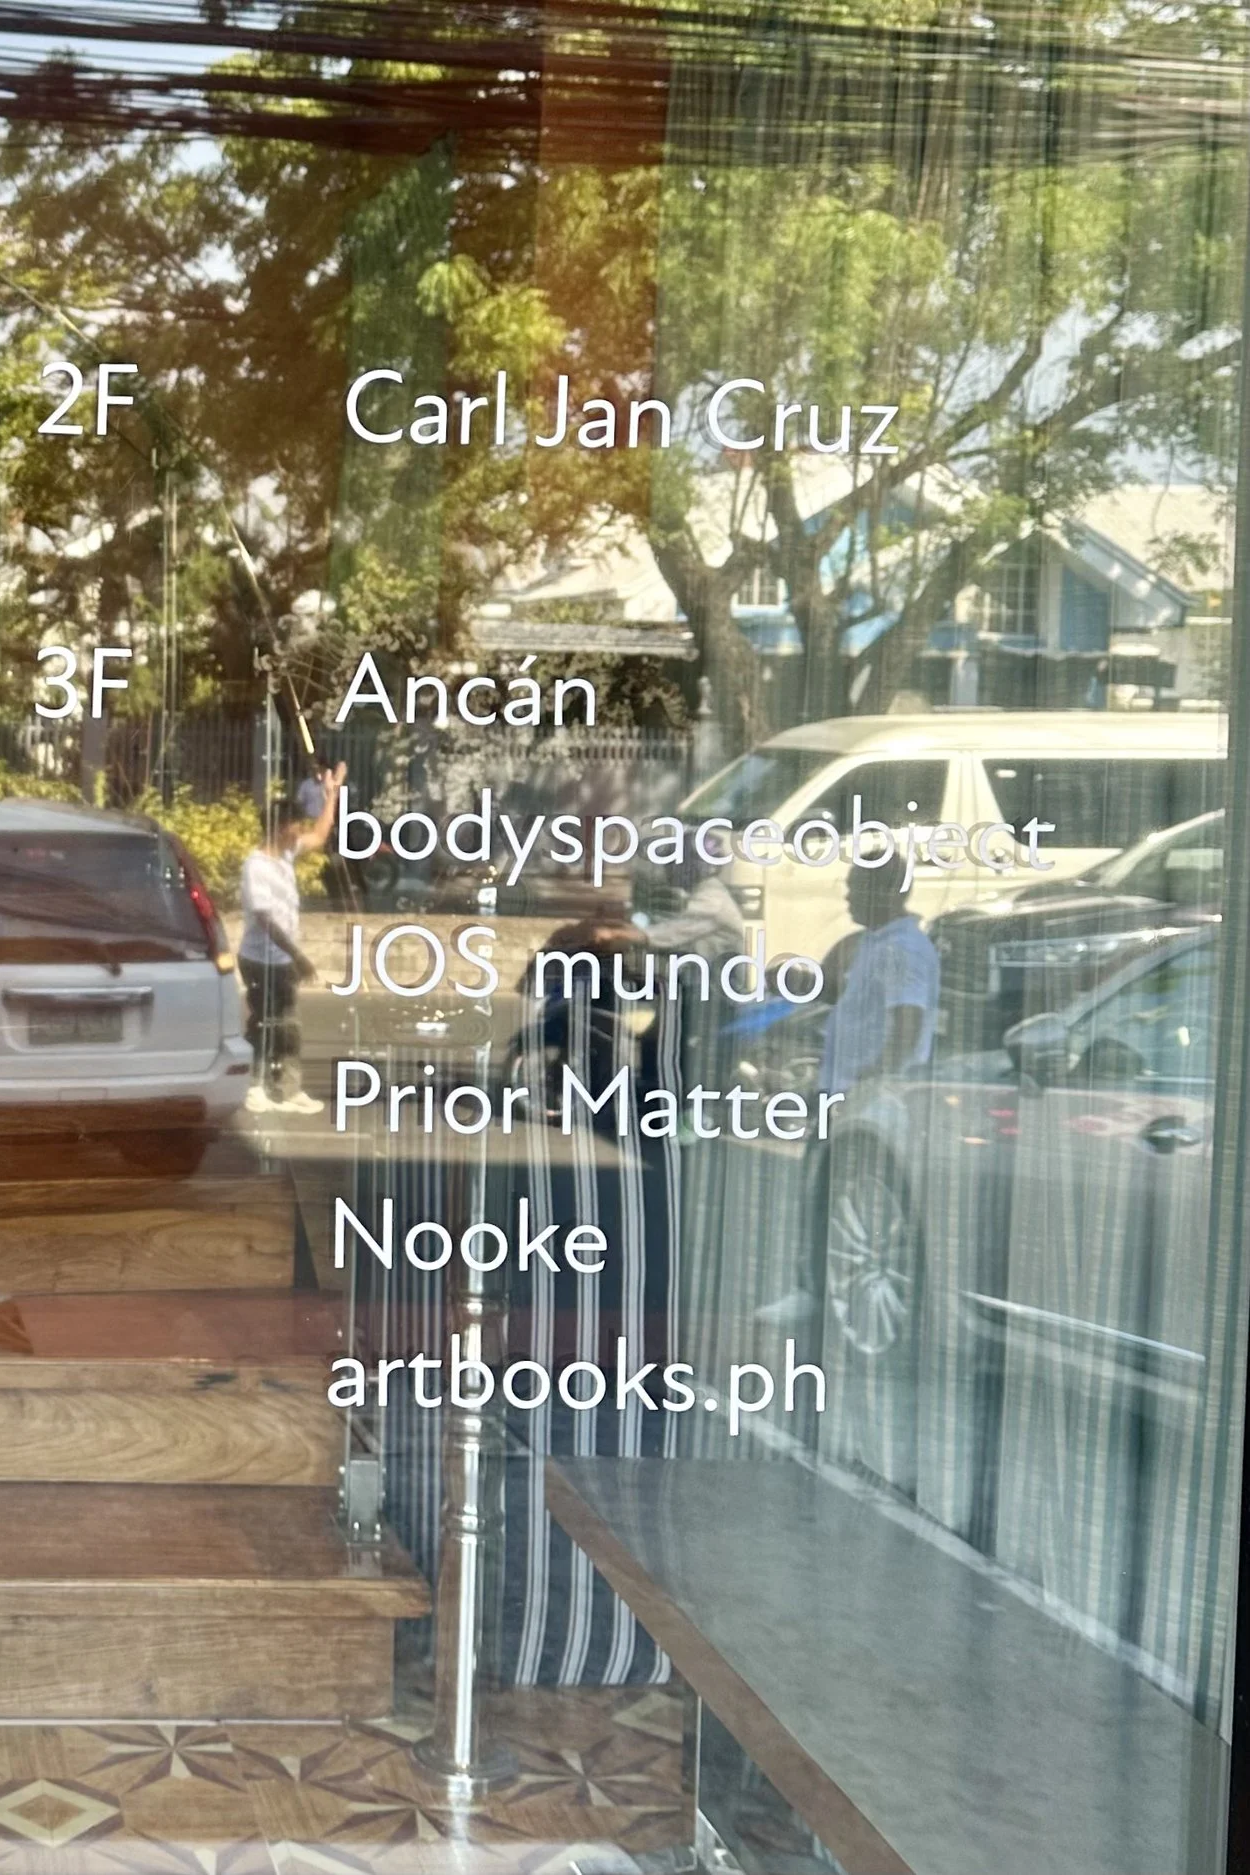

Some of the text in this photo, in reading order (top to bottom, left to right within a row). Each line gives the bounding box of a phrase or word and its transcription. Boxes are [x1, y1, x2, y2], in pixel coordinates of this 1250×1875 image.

[37, 361, 139, 436] 2F
[346, 368, 900, 455] Carl Jan Cruz
[34, 645, 133, 720] 3F
[334, 652, 596, 728] Ancán
[338, 784, 1057, 894] bodyspaceobject
[331, 923, 825, 1004] JOS mundo
[335, 1060, 846, 1141] Prior Matter
[333, 1196, 608, 1274] Nooke
[327, 1334, 826, 1437] artbooks.ph
